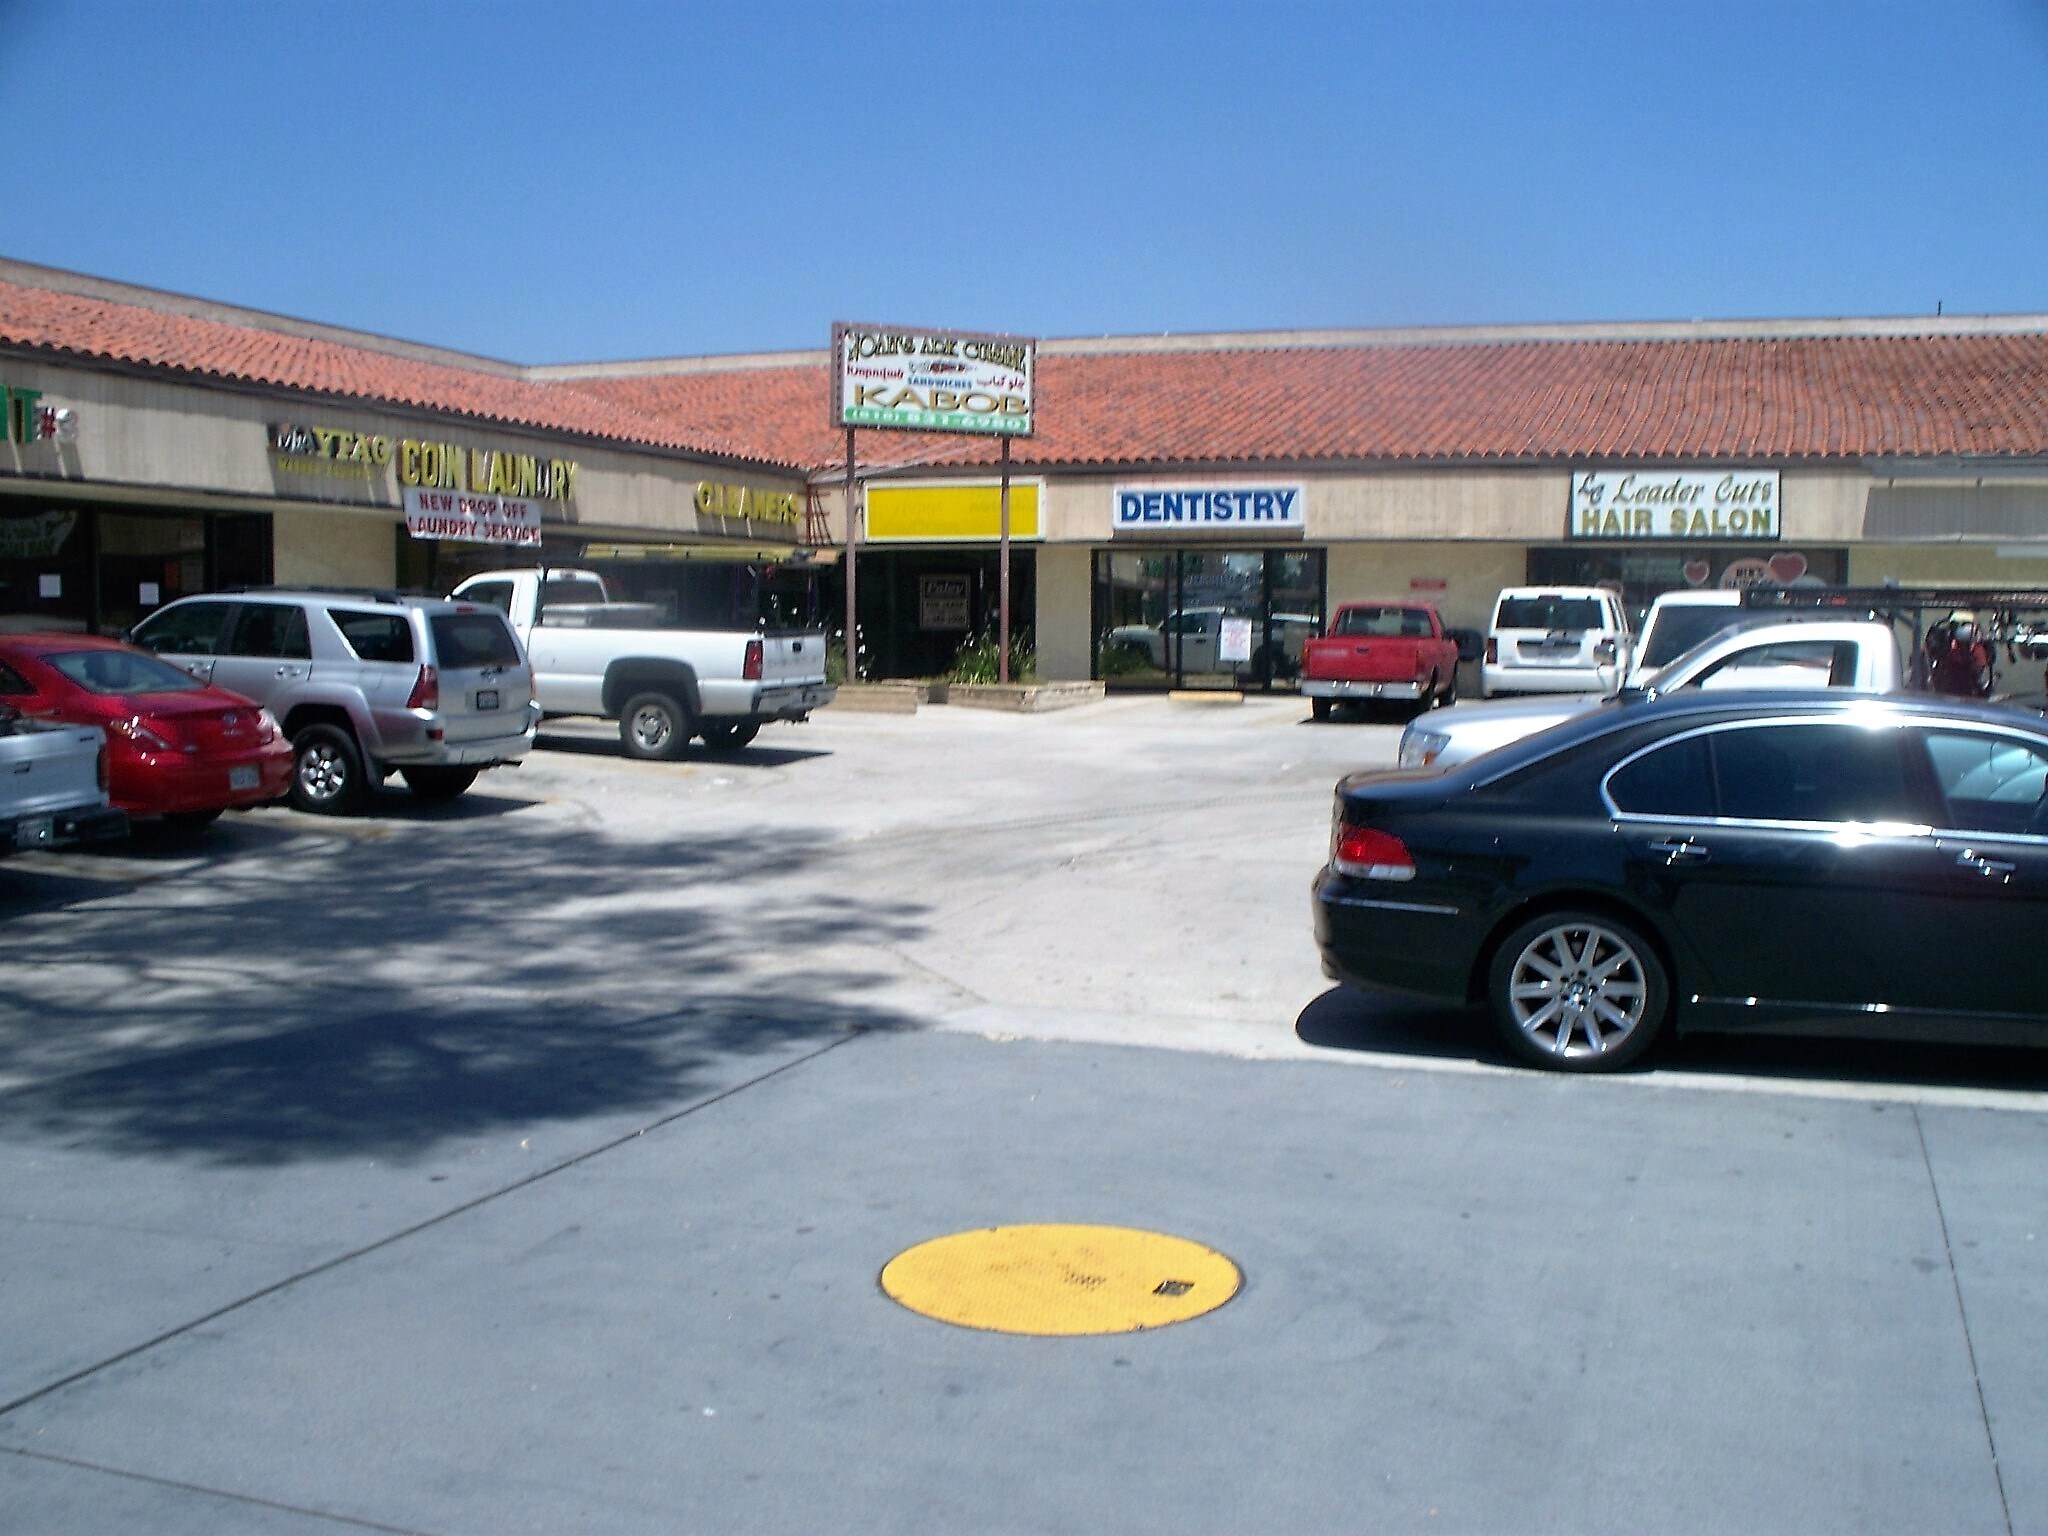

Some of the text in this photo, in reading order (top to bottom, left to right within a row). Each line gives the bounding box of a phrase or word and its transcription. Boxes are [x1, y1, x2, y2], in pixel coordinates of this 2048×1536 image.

[920, 335, 958, 357] ARK
[907, 375, 973, 390] SANDWICHES
[853, 384, 1028, 414] KABOB
[0, 385, 42, 444] T
[276, 425, 391, 465] MAYTAG
[401, 439, 467, 492] COIN
[471, 447, 579, 501] LAUNDRY
[696, 480, 801, 526] CLEANERS
[1612, 473, 1705, 505] Leader
[1714, 472, 1772, 505] Cuts
[418, 493, 527, 519] NEW DROP OFF
[1120, 492, 1299, 522] DENTISTRY
[407, 517, 477, 537] LAUNDRY
[1581, 508, 1771, 535] HAIR SALON
